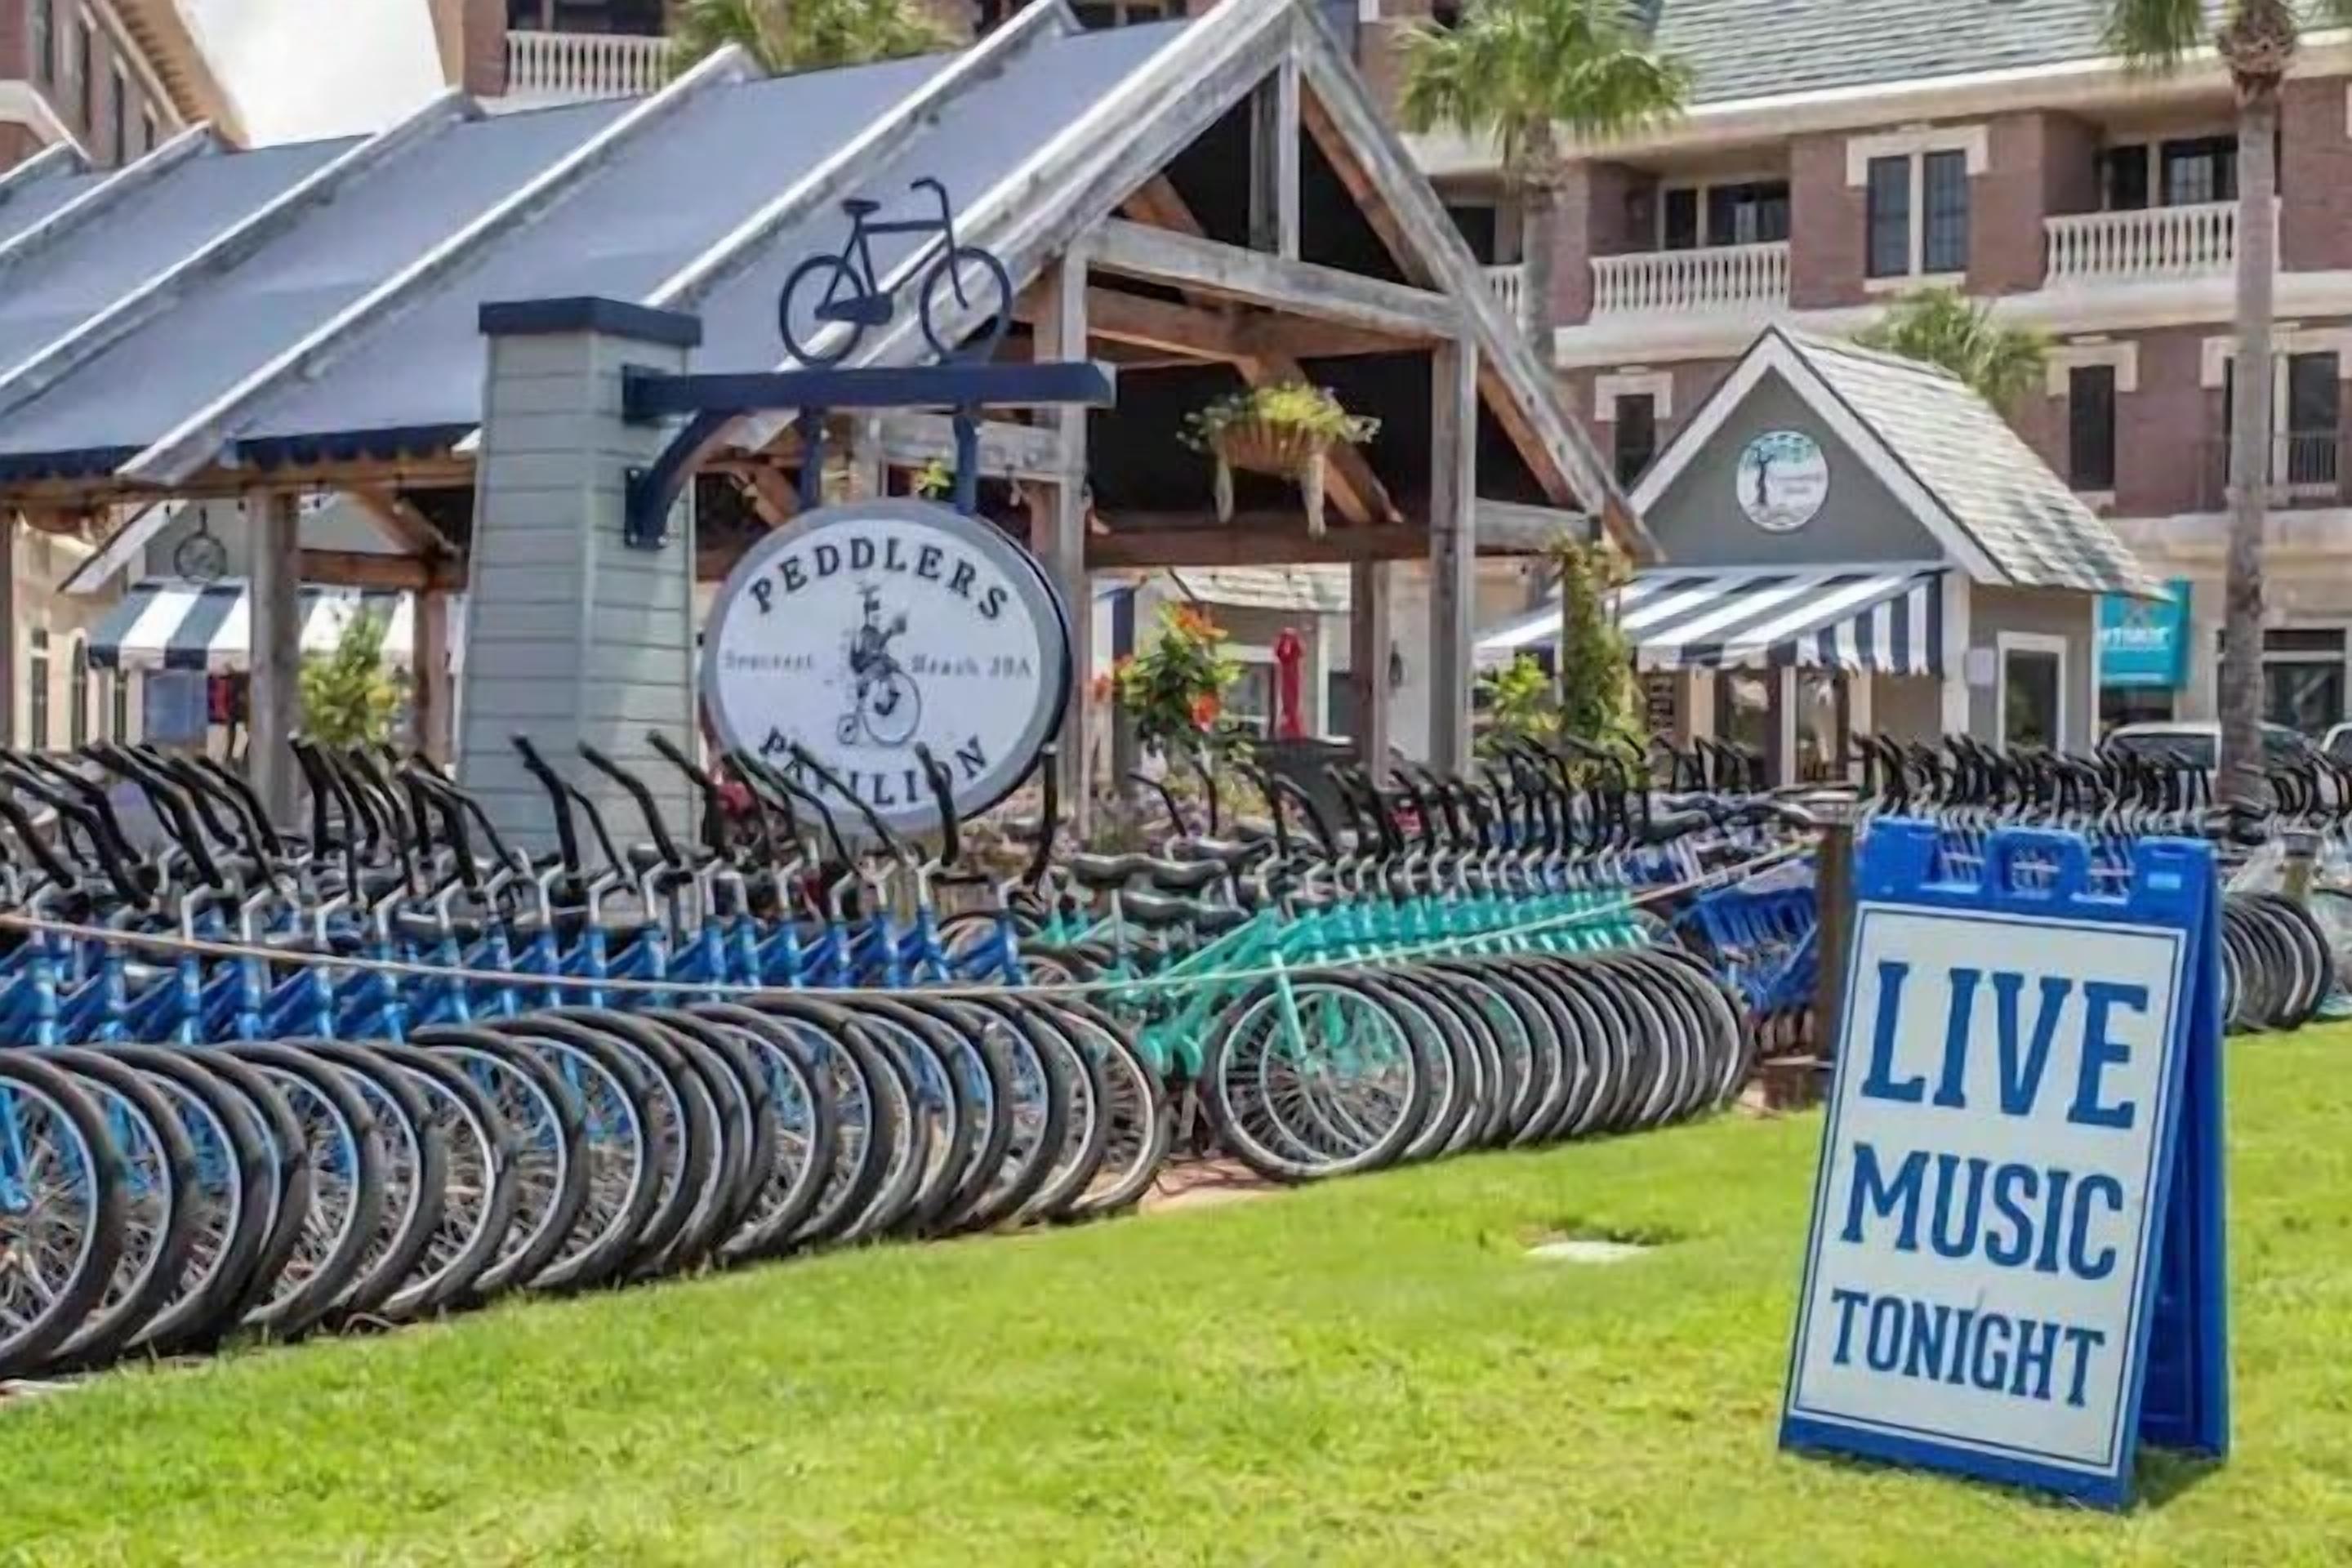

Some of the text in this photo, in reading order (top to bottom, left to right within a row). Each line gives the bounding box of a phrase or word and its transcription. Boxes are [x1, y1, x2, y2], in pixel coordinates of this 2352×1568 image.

[750, 537, 1008, 621] PEDDLERS
[1861, 961, 2148, 1129] LIVE
[1840, 1142, 2123, 1281] MUSIC
[1831, 1289, 2105, 1408] TONIGHT
